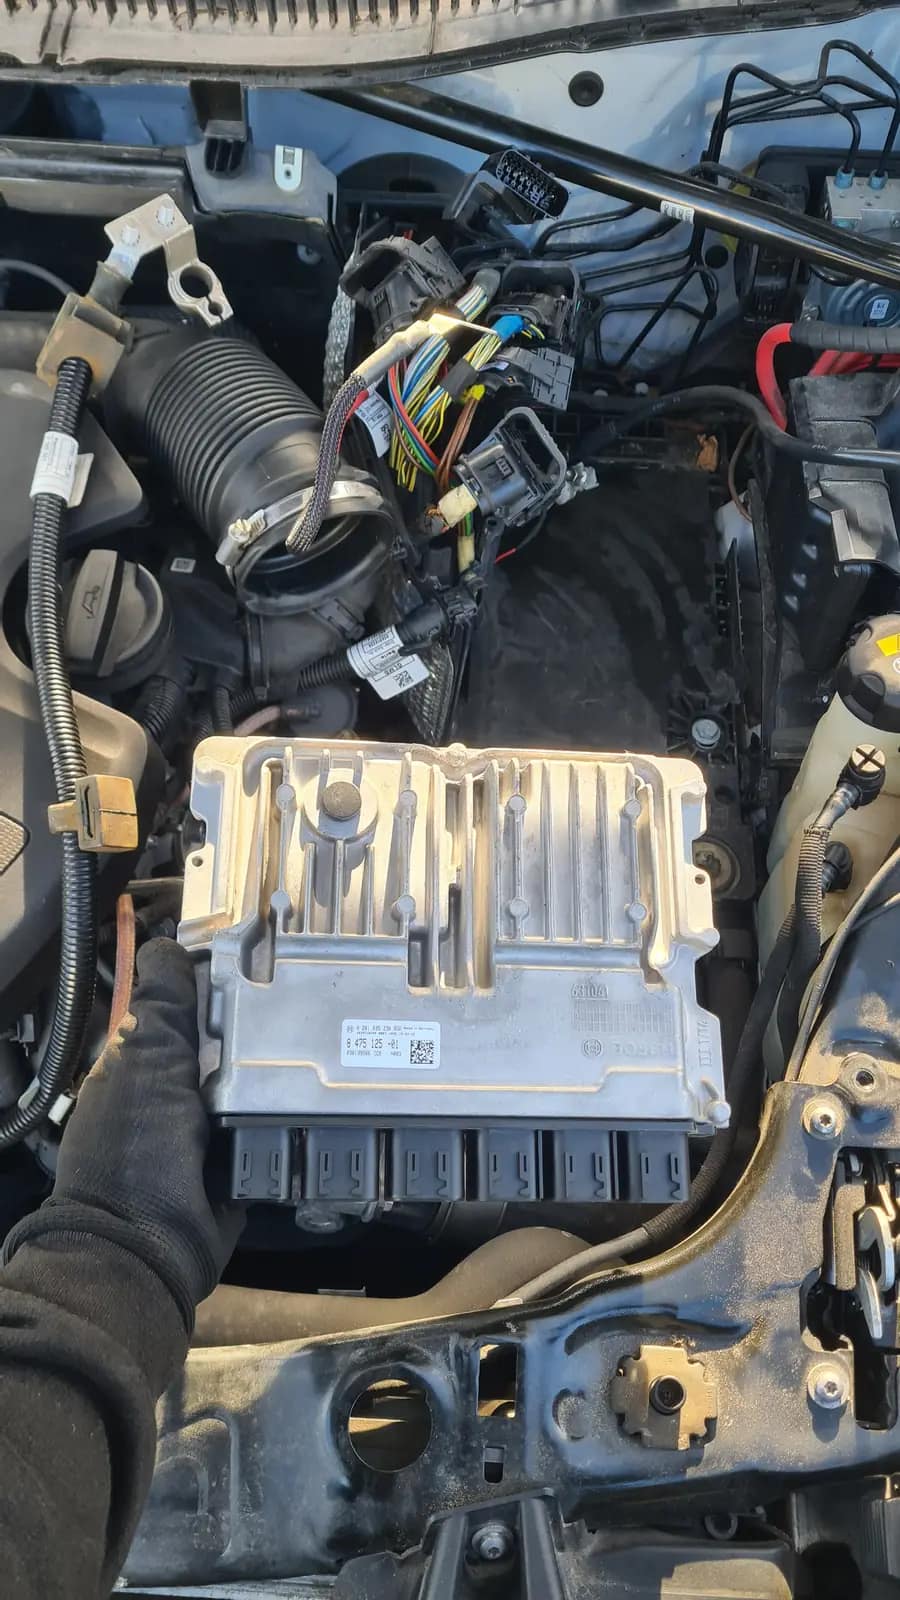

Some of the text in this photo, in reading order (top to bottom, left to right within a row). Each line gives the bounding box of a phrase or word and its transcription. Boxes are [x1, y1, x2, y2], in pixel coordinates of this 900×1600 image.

[346, 1038, 351, 1049] 8
[354, 1038, 367, 1049] 475
[371, 1038, 383, 1049] 125
